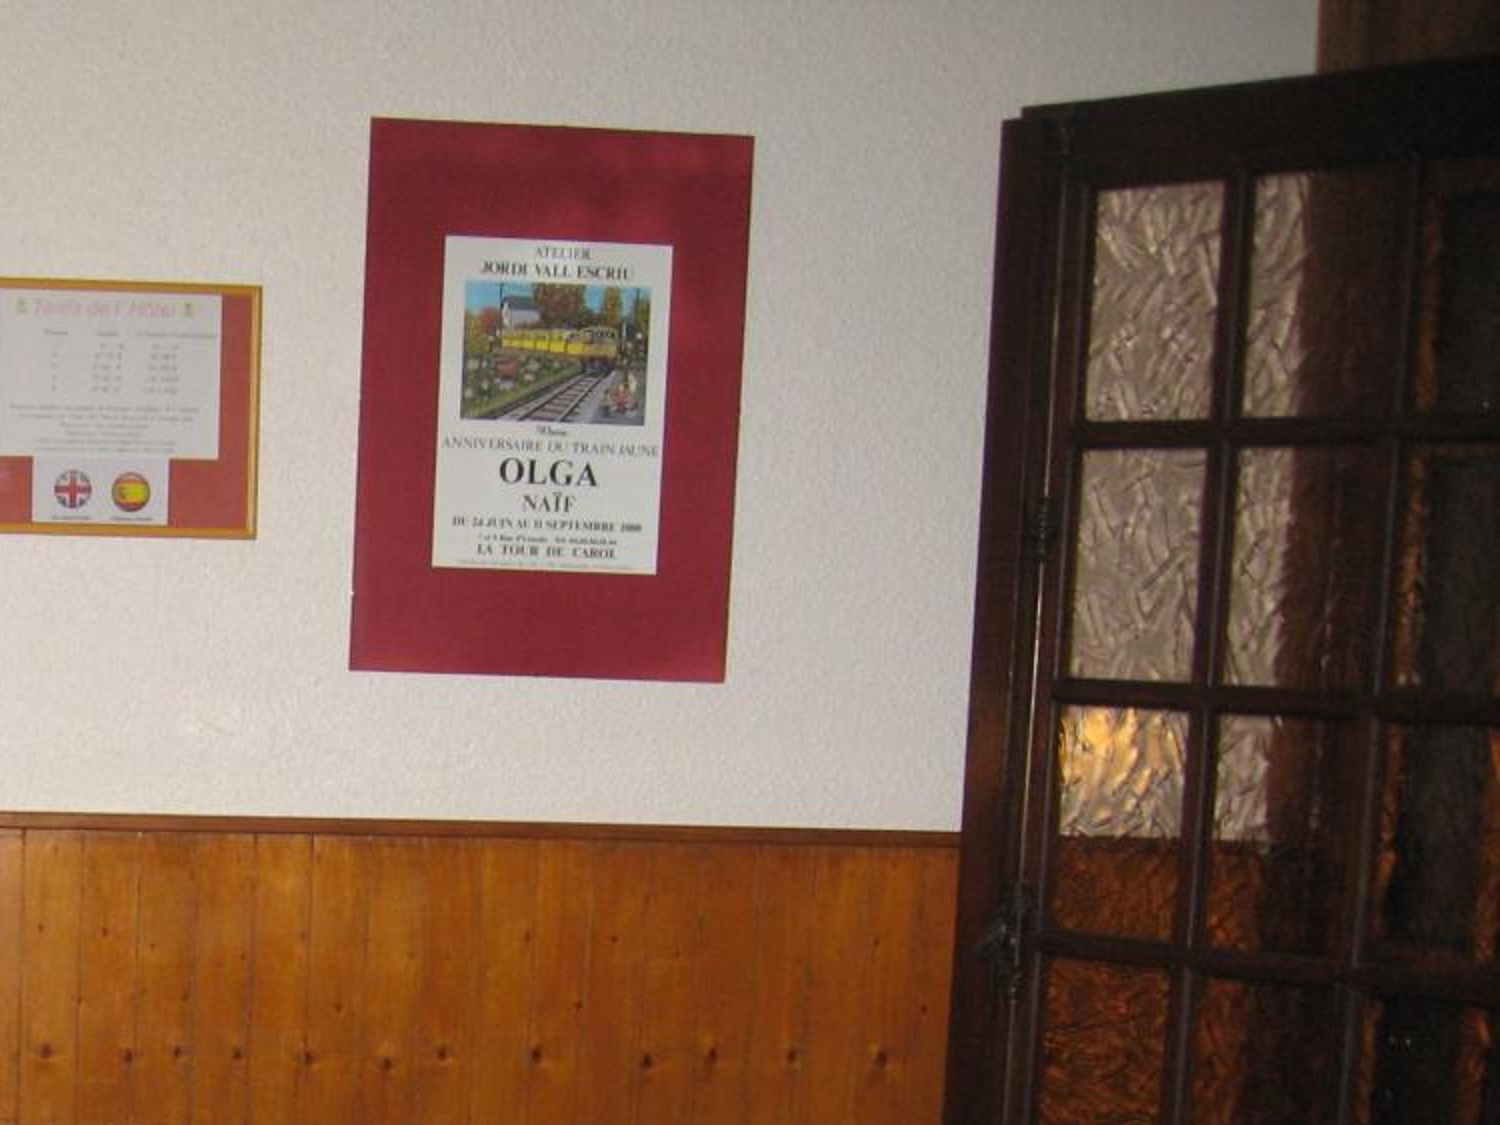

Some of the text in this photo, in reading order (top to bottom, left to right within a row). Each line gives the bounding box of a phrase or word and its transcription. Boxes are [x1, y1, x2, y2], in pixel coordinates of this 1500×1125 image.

[535, 246, 591, 260] ATELIER
[482, 260, 528, 276] JORDI
[535, 262, 573, 279] VALL
[444, 436, 544, 453] ANNIVERSAIRE
[573, 442, 616, 455] TRAIN
[499, 457, 597, 487] OLGA
[522, 492, 577, 513] NAÏF
[545, 520, 616, 533] SEPTEMBRE
[503, 545, 541, 557] TOUR
[571, 547, 617, 560] CAROL
